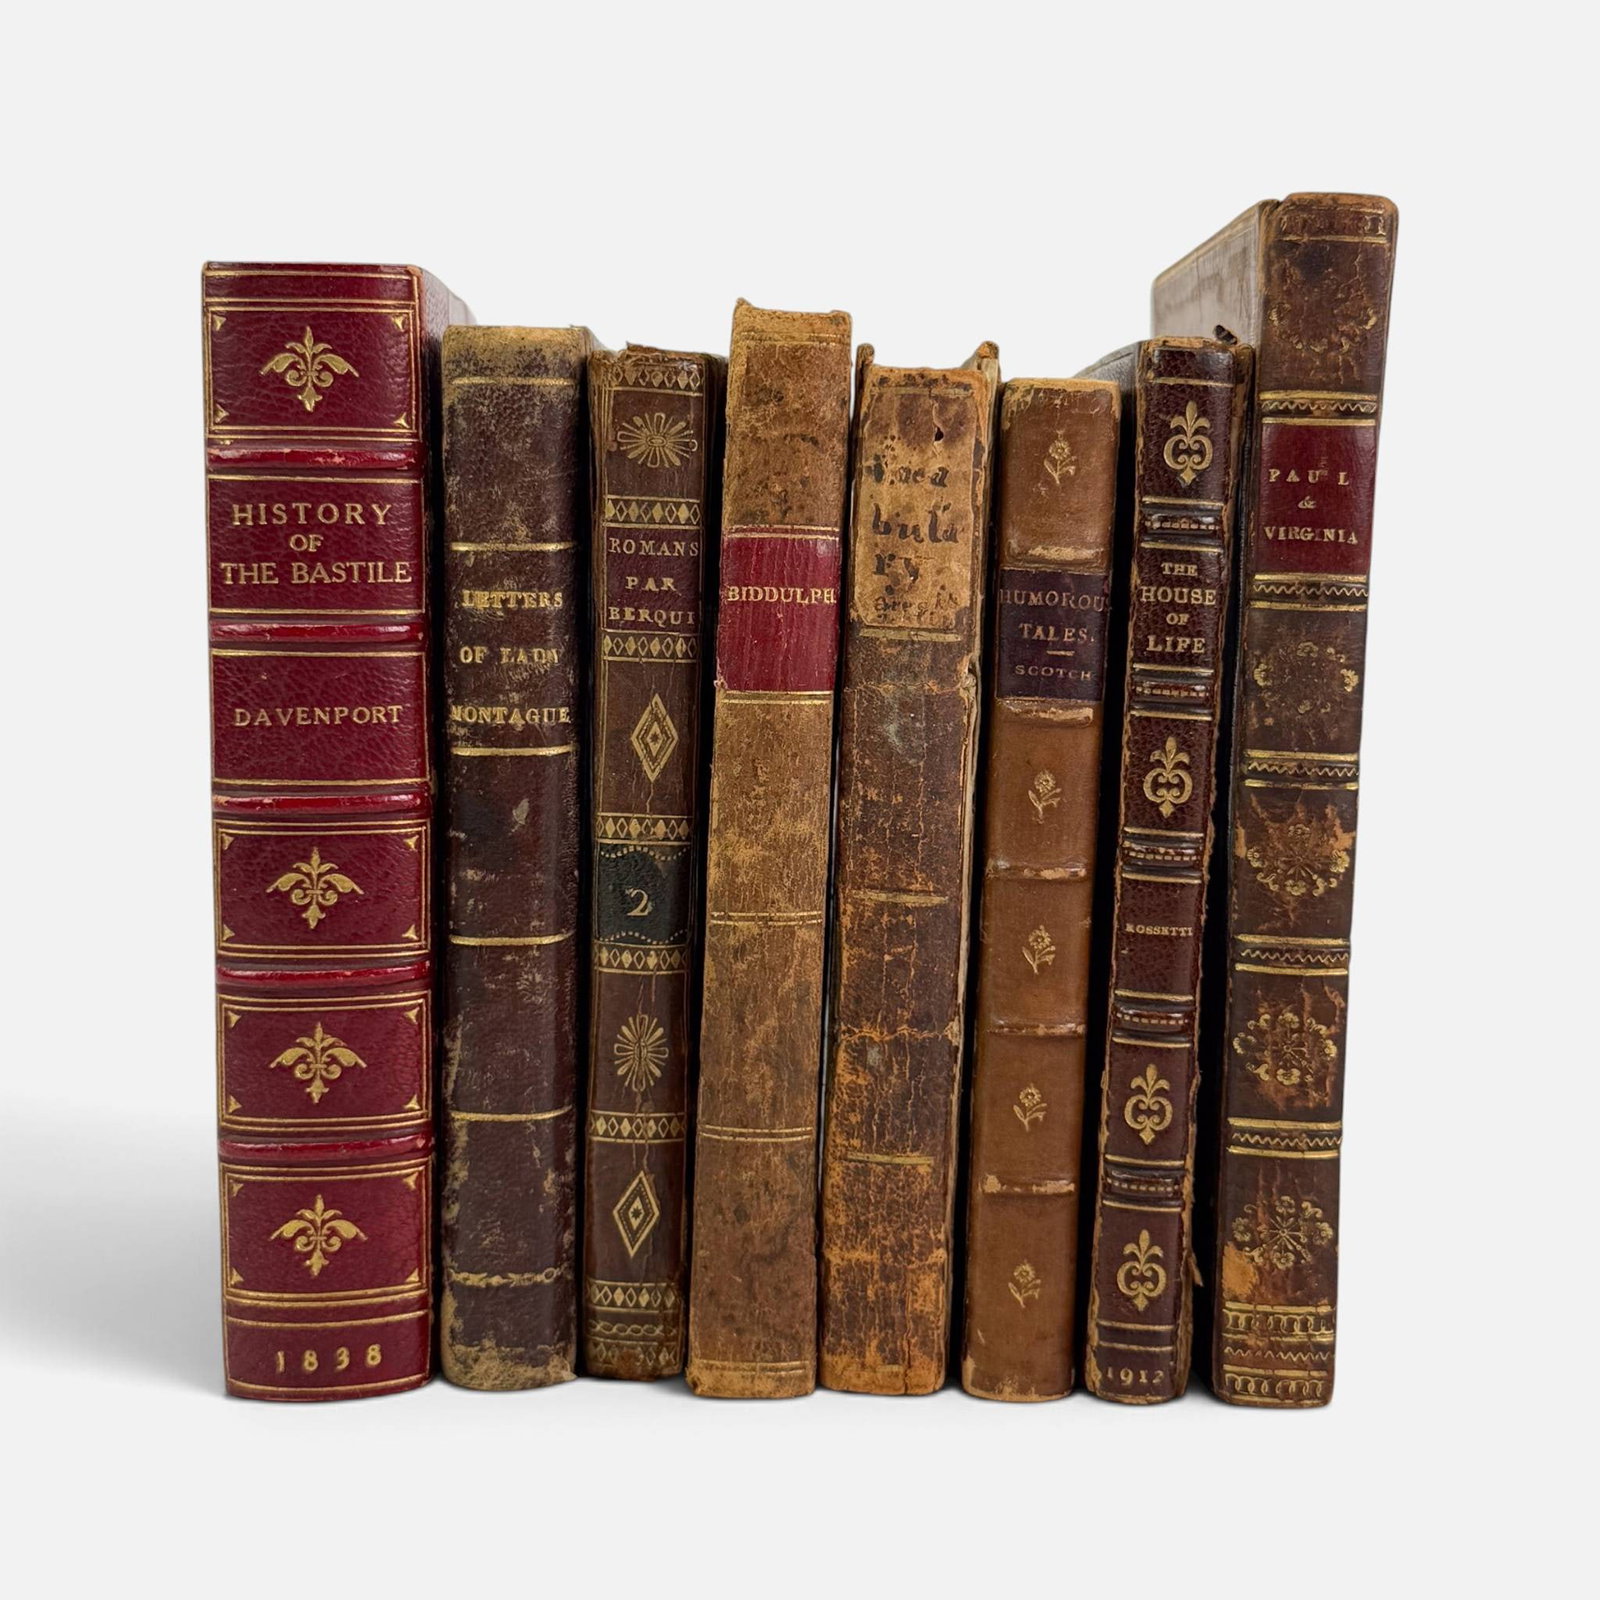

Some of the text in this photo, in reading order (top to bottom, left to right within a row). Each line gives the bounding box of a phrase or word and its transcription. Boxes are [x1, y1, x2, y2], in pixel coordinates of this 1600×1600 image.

[1268, 468, 1350, 486] PAUL
[1297, 496, 1317, 509] &
[231, 503, 392, 525] HISTORY
[289, 534, 324, 552] OF
[608, 537, 700, 557] ROMANS
[220, 562, 412, 585] THE BASTILE
[1160, 562, 1199, 577] THE
[625, 575, 677, 592] PAR
[461, 589, 563, 609] LETTERS
[727, 585, 837, 605] BIDDULPH
[1140, 586, 1217, 605] HOUSE
[1165, 612, 1190, 626] OF
[1146, 635, 1207, 654] LIFE
[459, 645, 488, 664] OF
[1015, 665, 1093, 681] SCOTCH
[234, 704, 403, 726] DAVENPORT
[450, 704, 571, 725] MONTAGUE
[625, 887, 653, 916] 2
[276, 1343, 382, 1373] 1838
